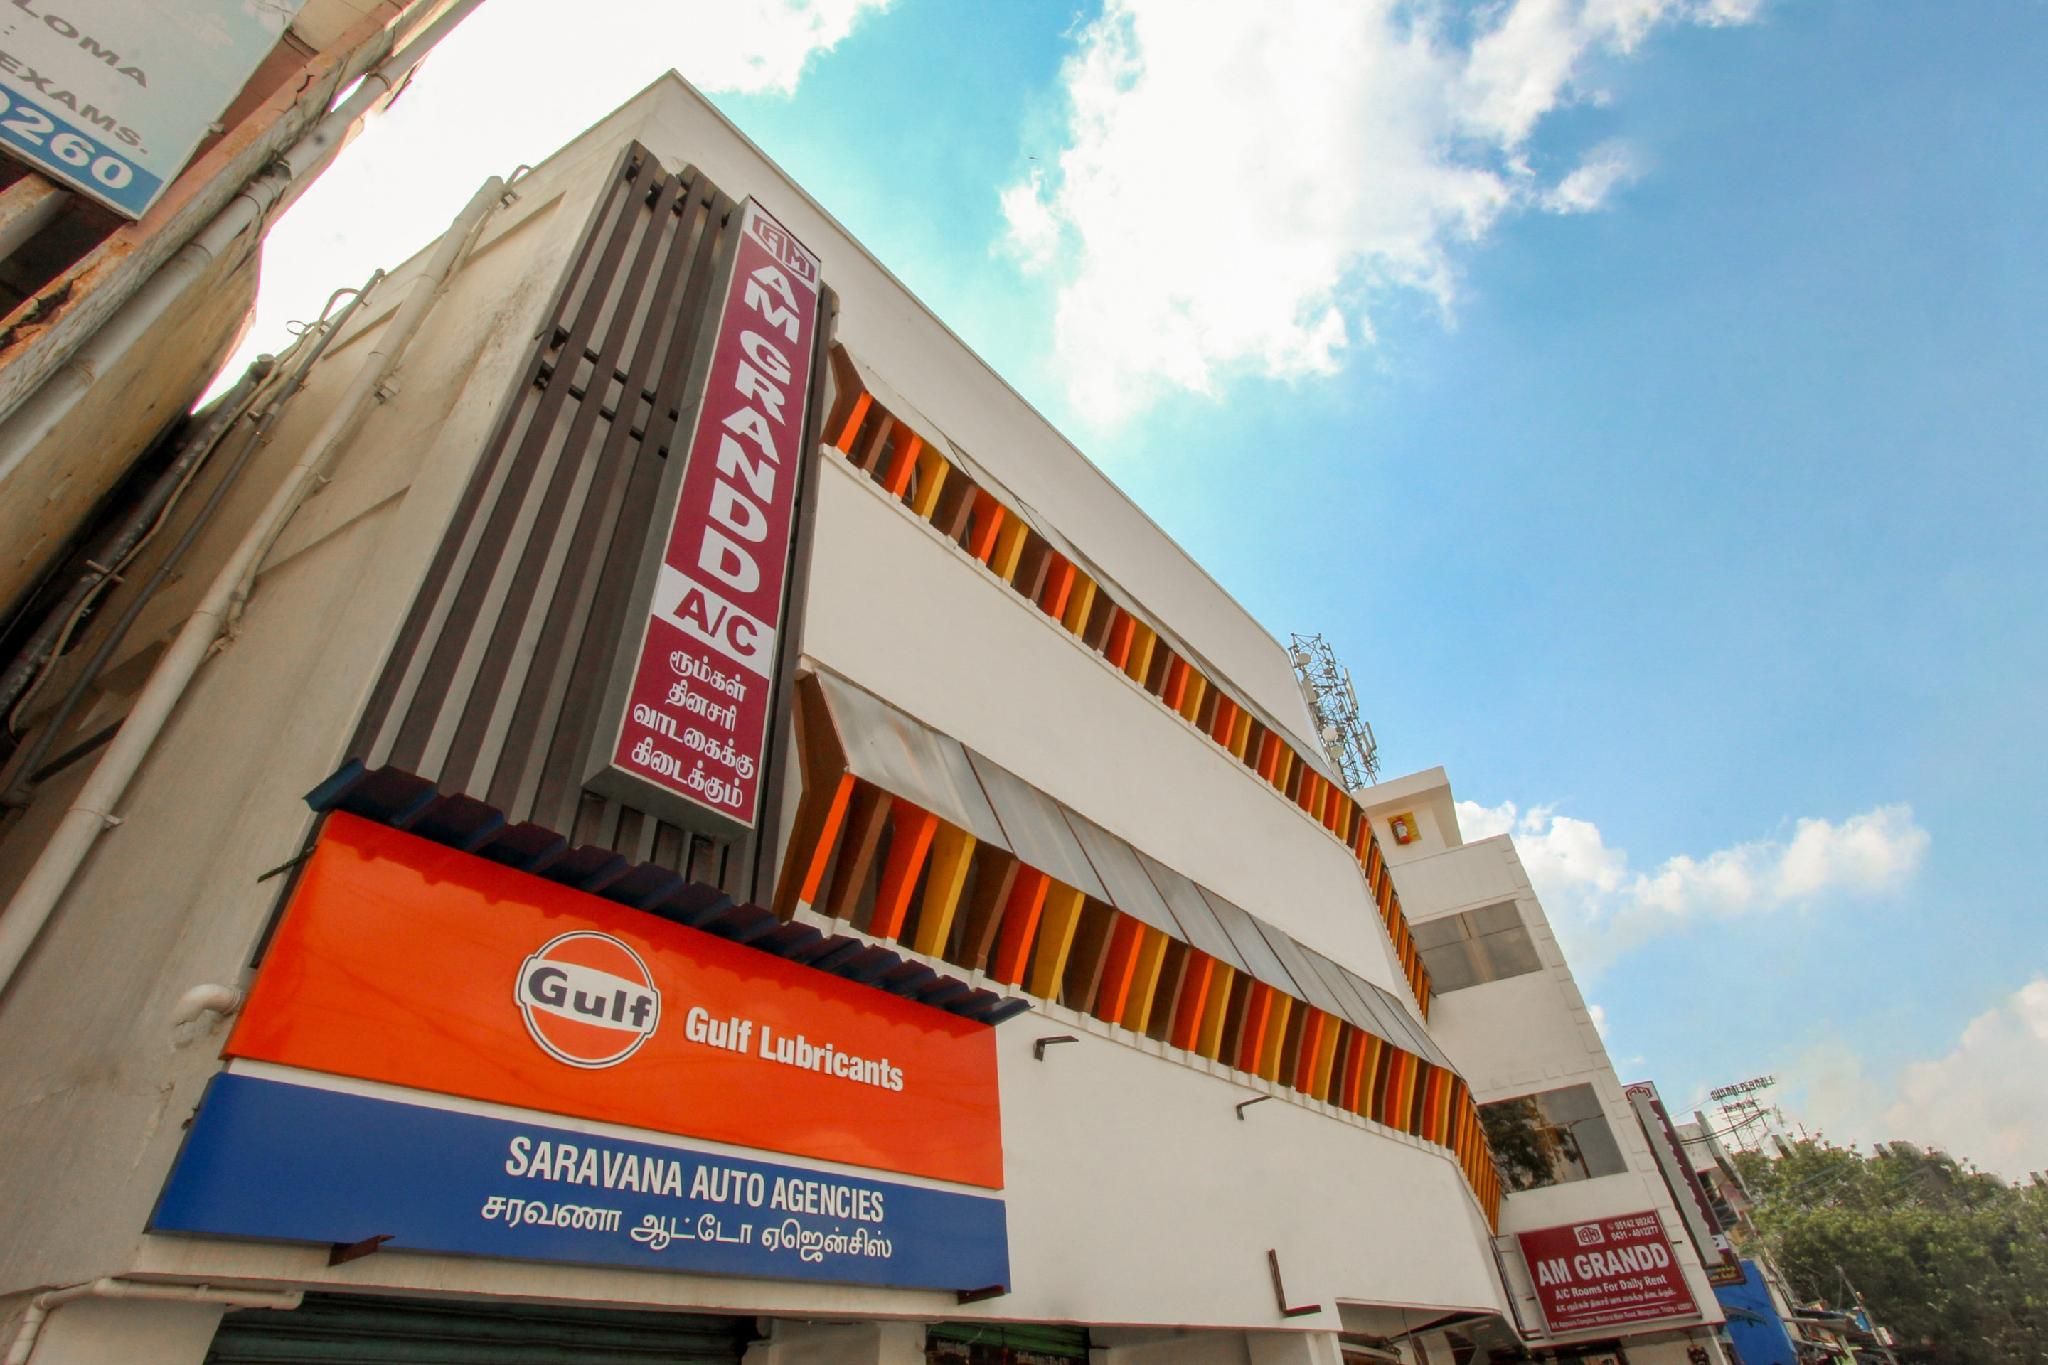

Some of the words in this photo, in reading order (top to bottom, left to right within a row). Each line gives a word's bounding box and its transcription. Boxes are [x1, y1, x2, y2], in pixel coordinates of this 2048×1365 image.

[0, 90, 134, 190] 260
[743, 265, 800, 345] AM
[697, 330, 792, 594] GRANDD
[672, 587, 758, 658] A/C
[664, 679, 737, 733] தினசரி
[669, 650, 748, 703] ரூம்கள்
[630, 736, 744, 809] கிடைக்கும்
[633, 703, 754, 780] வாடகைக்கு
[527, 966, 653, 1030] Gulf
[684, 1005, 753, 1054] Gulf
[759, 1024, 905, 1093] Lubricants
[504, 1135, 684, 1198] SARAVANA
[689, 1163, 766, 1207] AUTO
[770, 1175, 885, 1223] AGENCIES
[480, 1194, 622, 1234] சரவணா
[629, 1212, 754, 1251] ஆட்டோ
[761, 1216, 893, 1262] ஏஜென்சிஸ்
[1537, 1257, 1573, 1287] AM
[1574, 1242, 1671, 1281] GRANDD
[1571, 1284, 1602, 1298] Rooms
[1603, 1281, 1618, 1292] For
[1620, 1277, 1644, 1291] Daily
[1645, 1273, 1668, 1286] Rent
